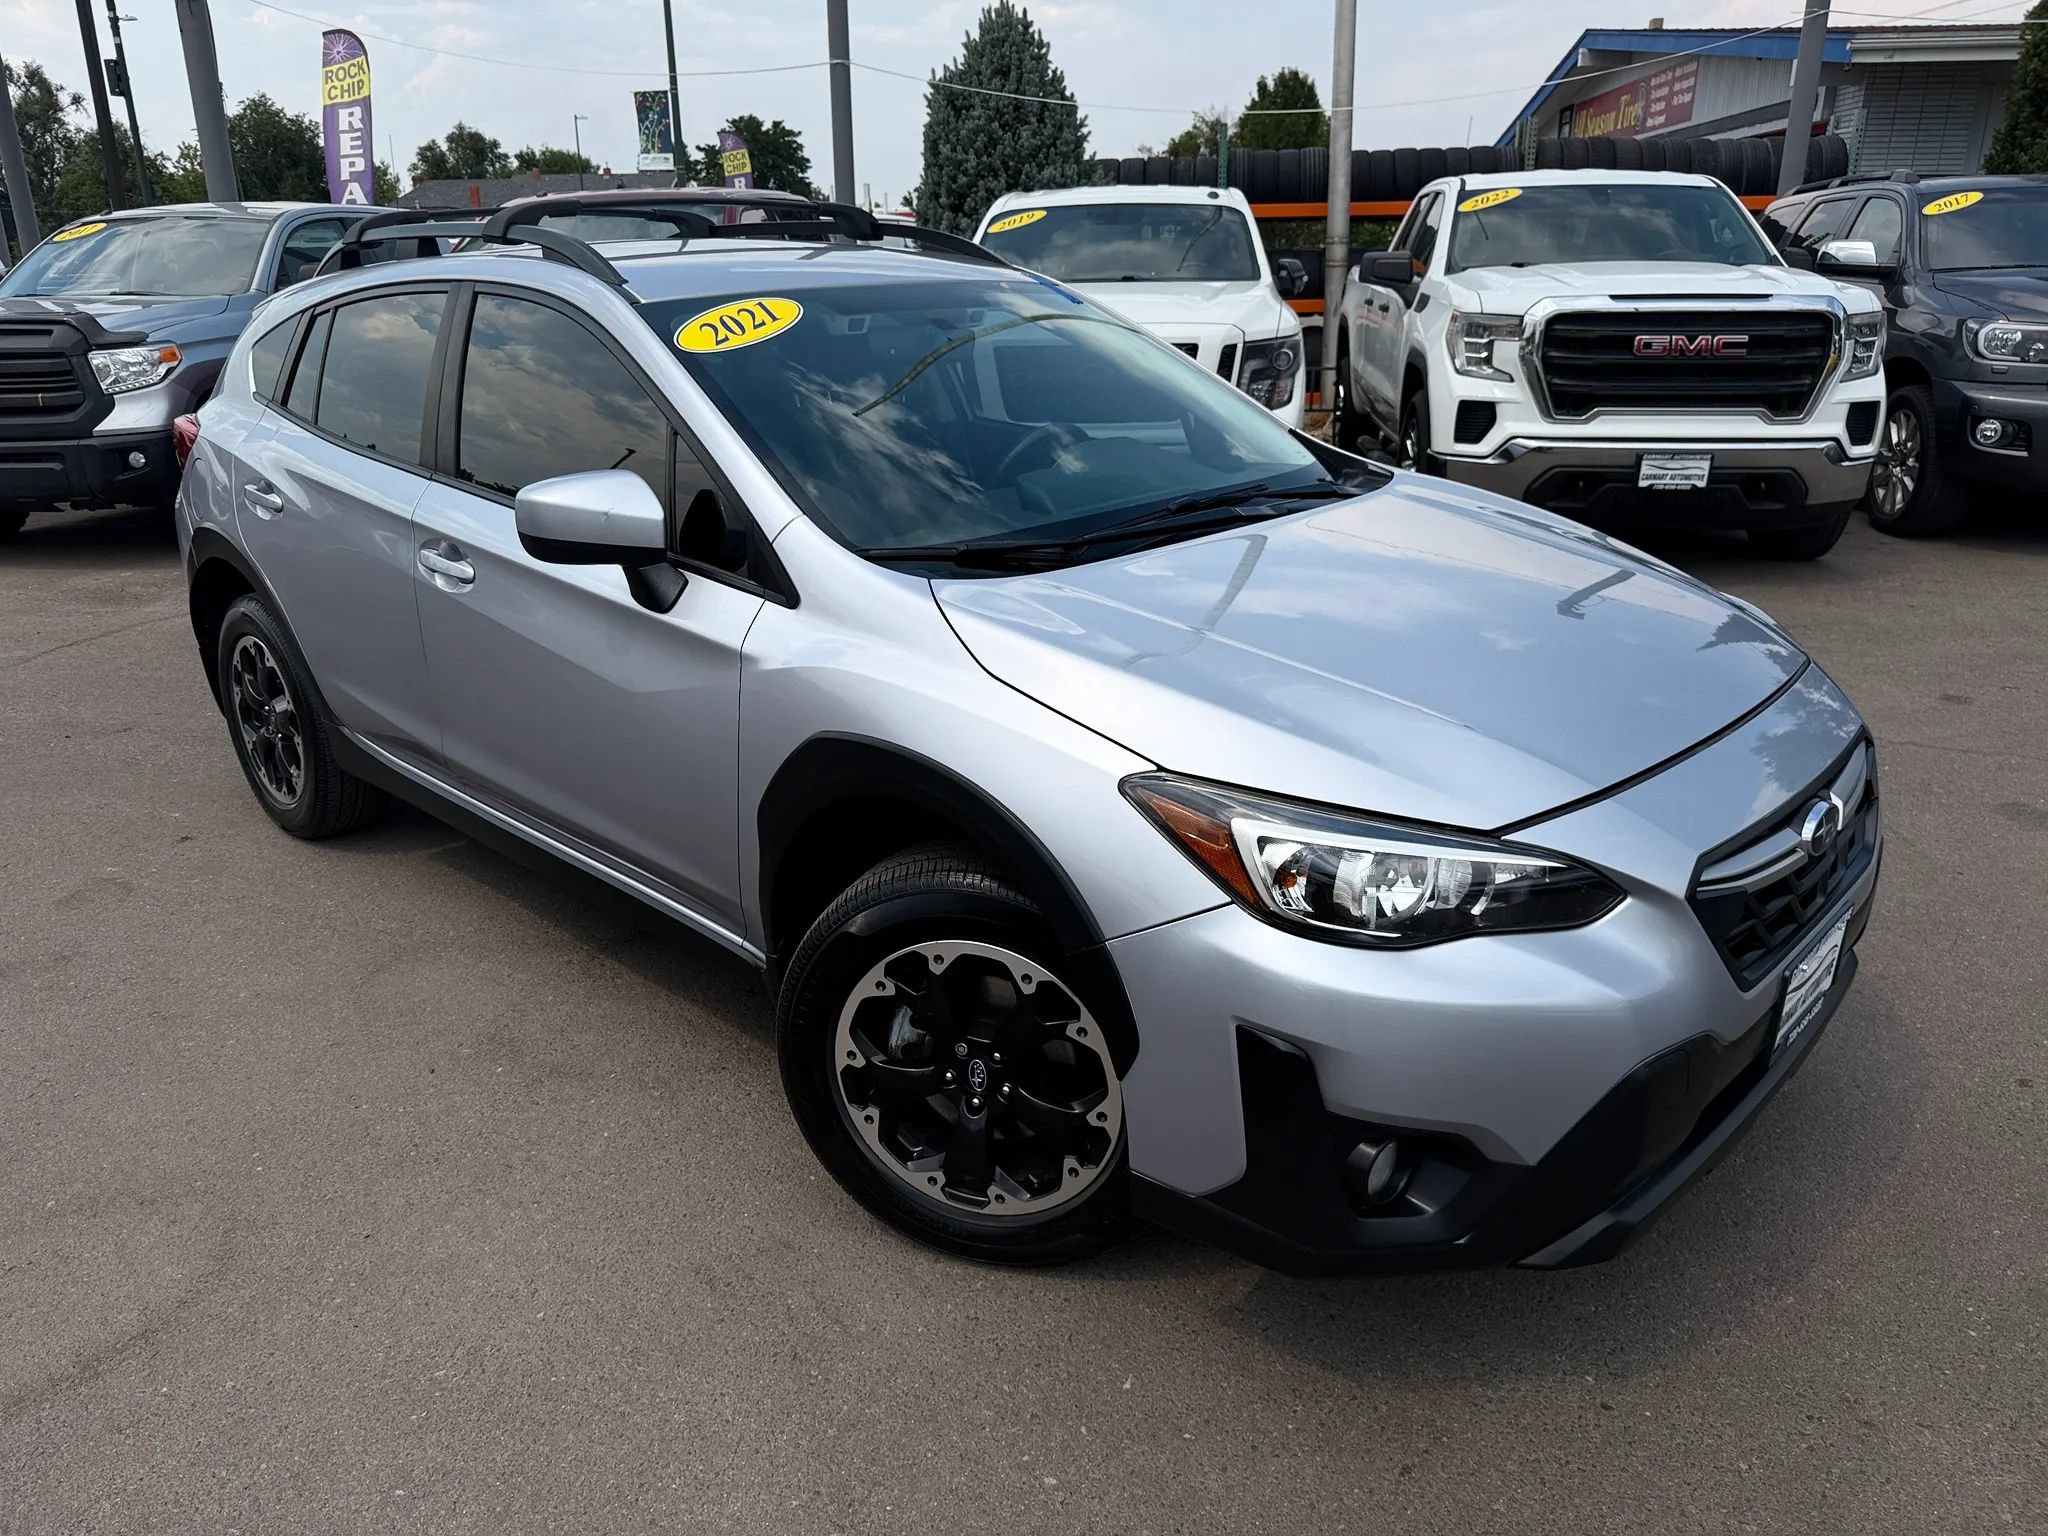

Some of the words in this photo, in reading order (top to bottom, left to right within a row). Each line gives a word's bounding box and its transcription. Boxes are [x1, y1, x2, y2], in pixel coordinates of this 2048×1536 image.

[324, 59, 367, 85] ROCK
[327, 79, 366, 101] CHIP
[1587, 107, 1617, 137] Season
[338, 106, 369, 205] REPA
[724, 151, 747, 163] ROCK
[725, 162, 748, 174] CHIP
[1471, 190, 1509, 208] 2022
[1933, 193, 1969, 212] 2017
[999, 213, 1034, 230] 2019
[699, 301, 783, 346] 2021
[1633, 335, 1749, 356] GMC
[1641, 473, 1668, 481] CARMART
[1669, 473, 1705, 482] AUTOMOTIVE
